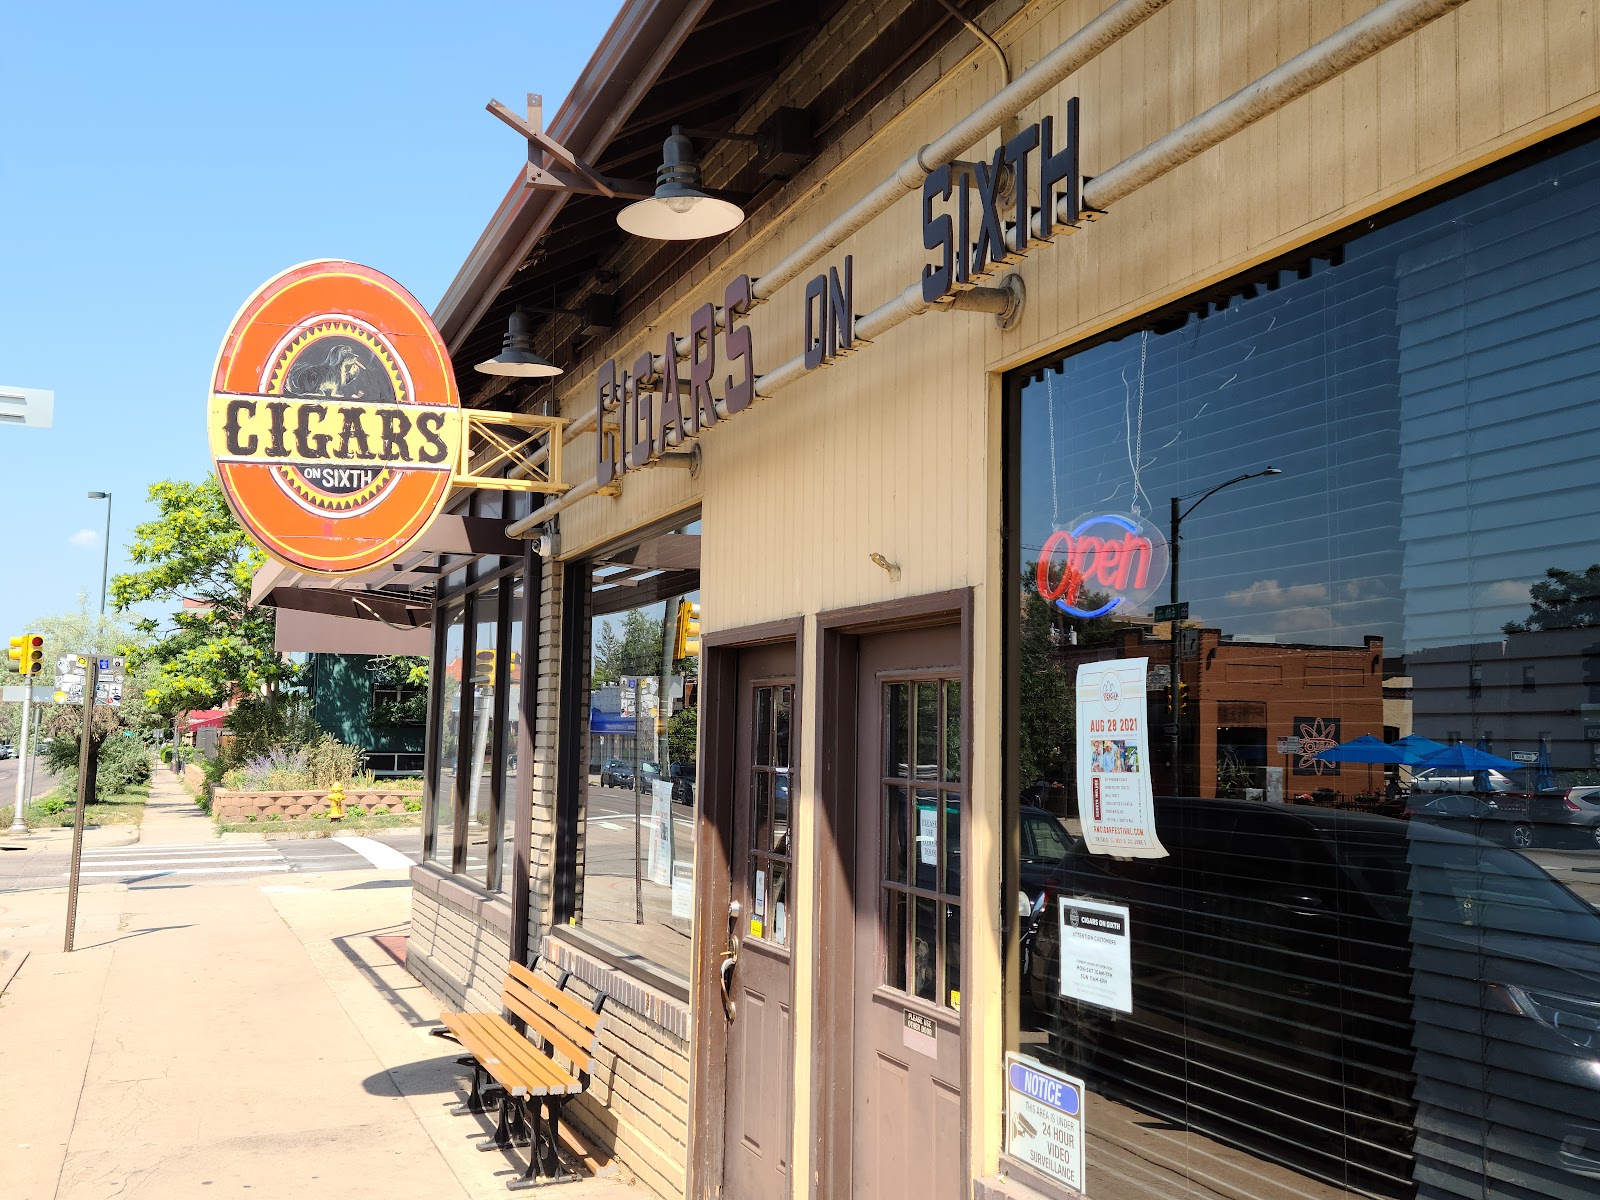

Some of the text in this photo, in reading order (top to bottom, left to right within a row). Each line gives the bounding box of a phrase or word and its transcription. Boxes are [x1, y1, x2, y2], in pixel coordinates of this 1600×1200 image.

[597, 97, 1079, 486] CIGARS ON SIXTH
[222, 400, 449, 463] CIGARS
[304, 468, 372, 488] ON SIXTH
[1036, 530, 1152, 606] Open
[1090, 717, 1138, 732] AUG 28 2021
[1081, 916, 1098, 926] CIGARS
[1106, 921, 1121, 931] SIXTH
[1072, 931, 1117, 946] ATTENTION CUSTOMERS
[907, 1020, 933, 1036] OTHER DOOR
[908, 1012, 932, 1028] PLEASE USE
[1024, 1070, 1063, 1107] NOTICE
[1025, 1101, 1074, 1132] THIS AREA IS UNDER
[1042, 1122, 1074, 1149] 24 HOUR
[1029, 1149, 1075, 1182] SURVEILLANCE
[1046, 1141, 1070, 1165] VIDEO
